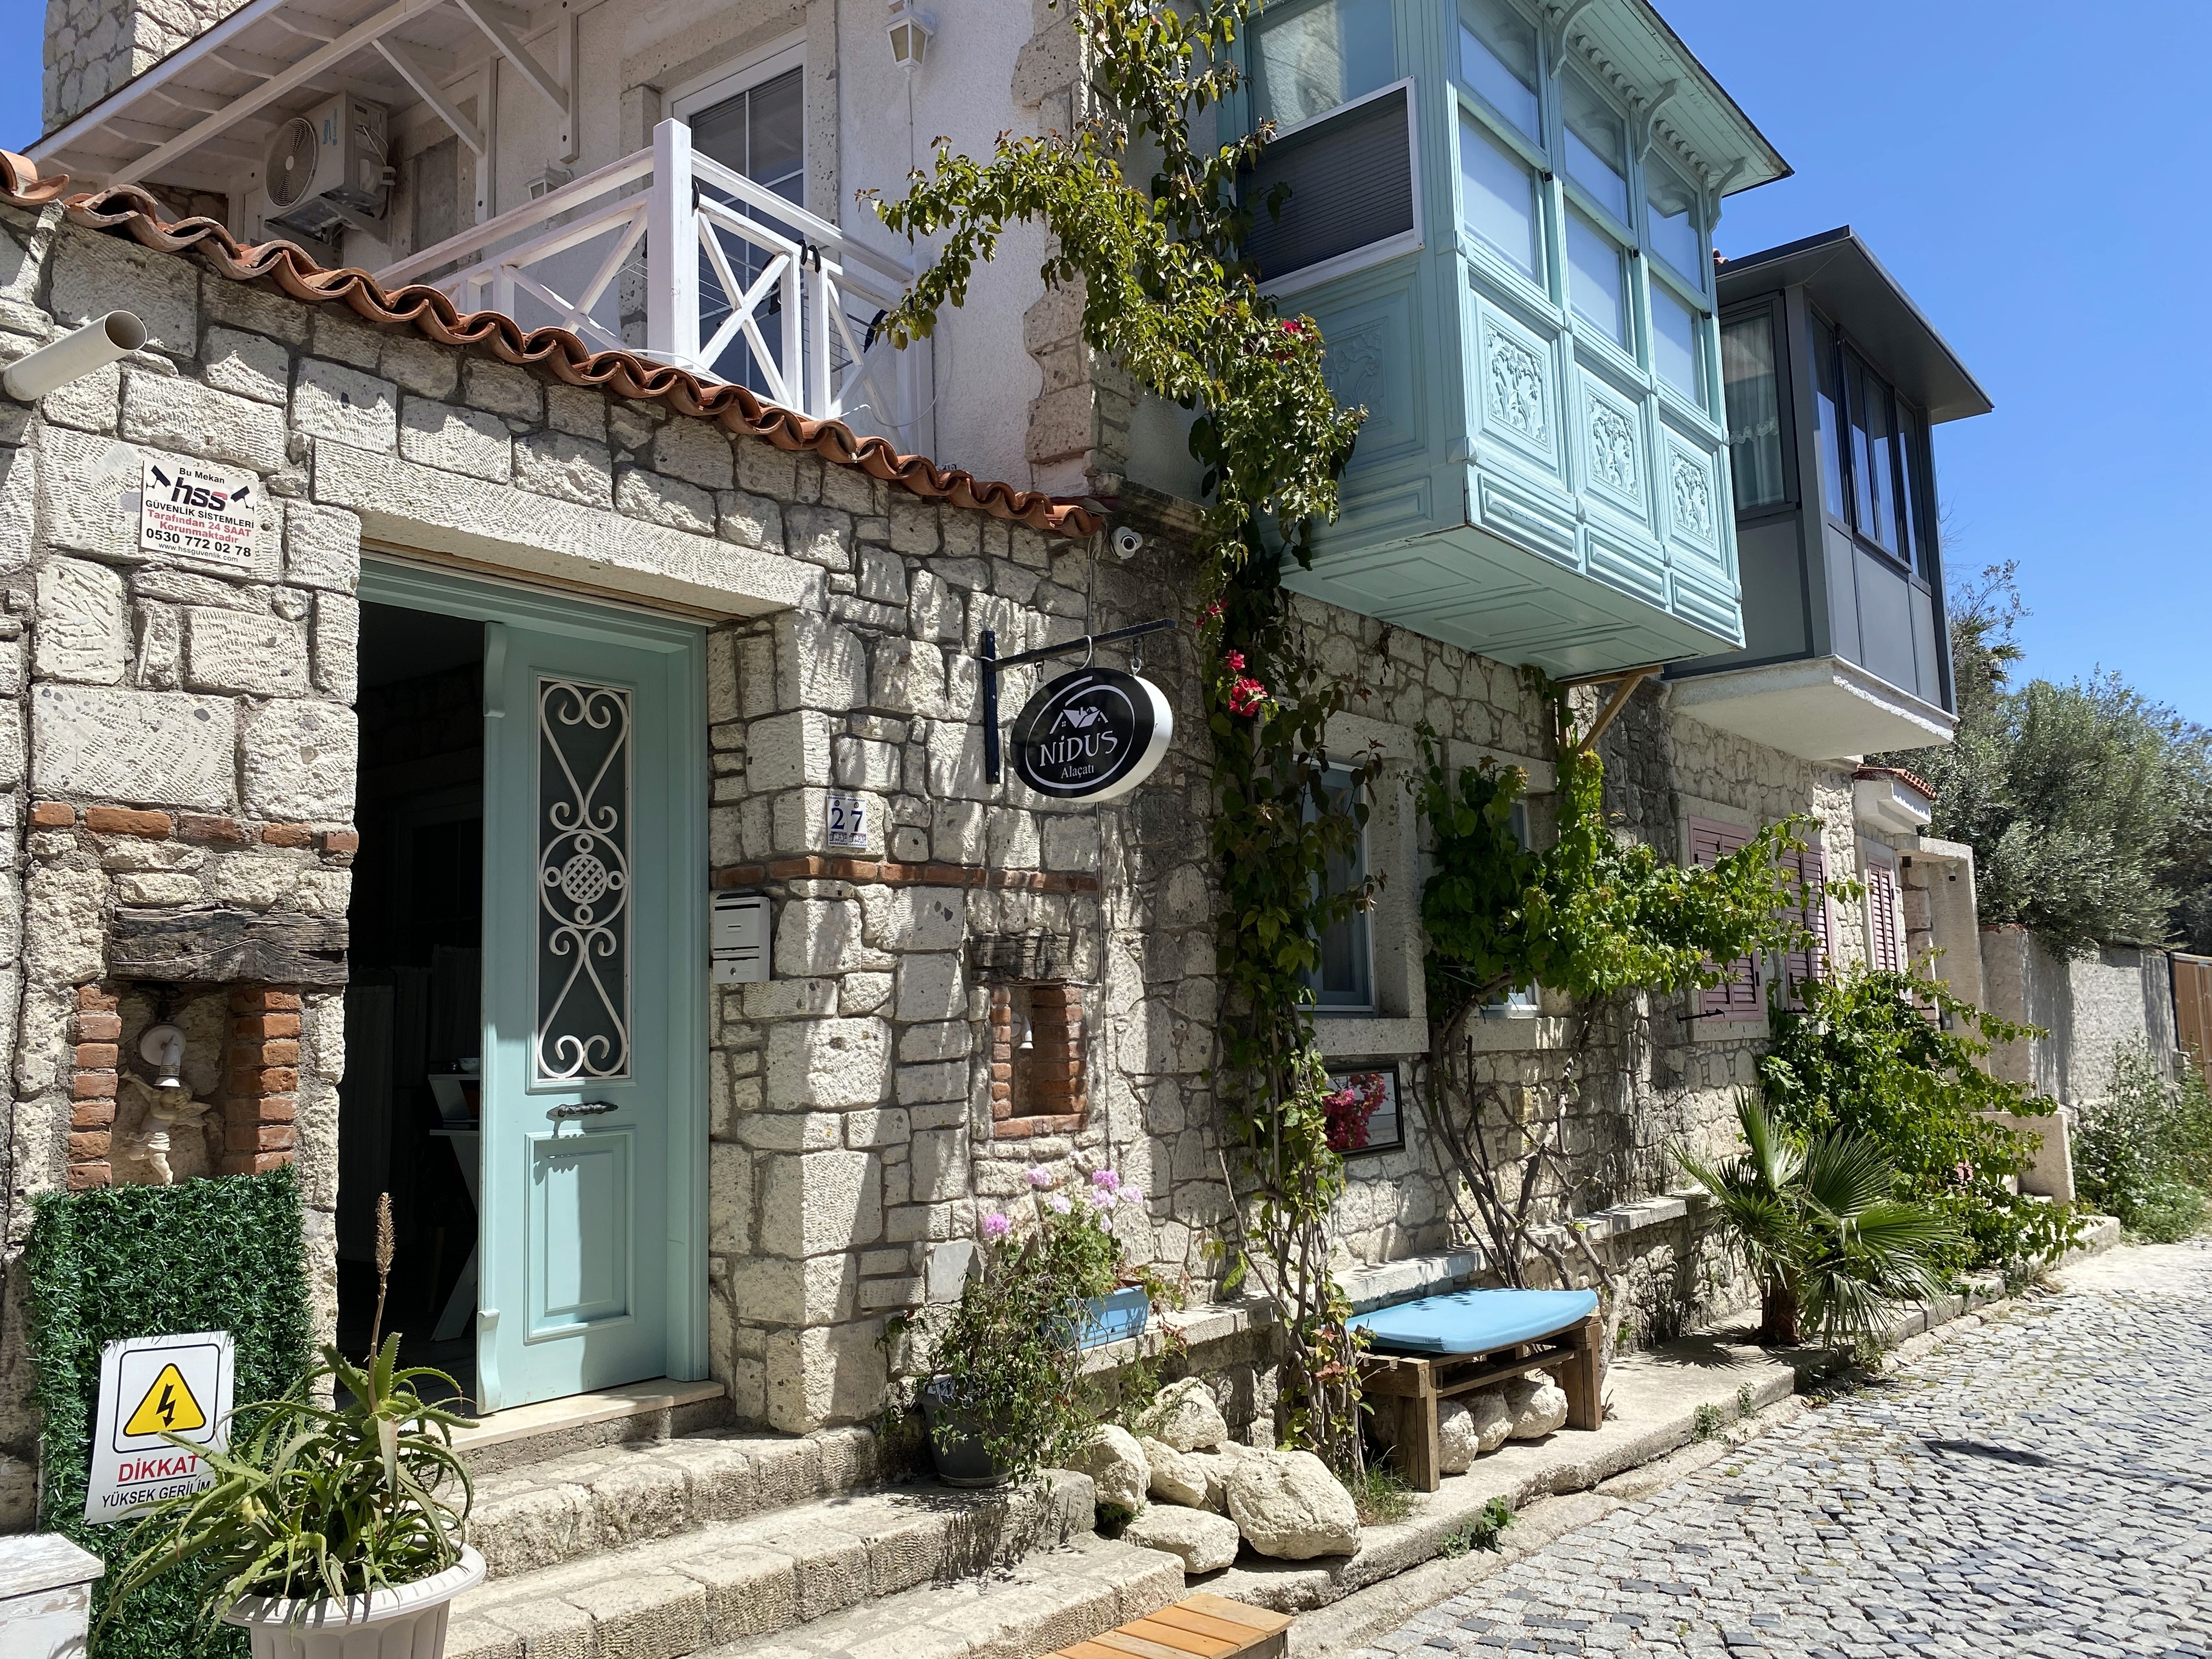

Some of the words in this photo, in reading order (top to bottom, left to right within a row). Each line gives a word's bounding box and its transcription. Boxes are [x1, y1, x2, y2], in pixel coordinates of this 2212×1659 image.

[179, 467, 192, 477] Bu
[195, 471, 225, 484] Mekan
[171, 476, 228, 512] hss
[145, 500, 195, 517] GÜVENLİK
[198, 509, 254, 529] SİSTEMLERİ
[147, 509, 205, 528] Tarafından
[208, 522, 221, 531] 24
[224, 525, 252, 537] SAAT
[146, 528, 180, 544] 0530
[185, 535, 210, 549] 772
[215, 541, 230, 554] 02
[235, 545, 252, 557] 78
[160, 521, 239, 544] Korunmaktadır
[158, 543, 239, 563] www.hssguvenlik.com
[1039, 730, 1118, 767] NİDUS
[1060, 765, 1095, 779] Alaçatı
[830, 807, 864, 832] 27
[117, 1454, 199, 1483] DİKKAT
[102, 1487, 156, 1508] YÜKSEK
[159, 1479, 211, 1499] GERİLİM
